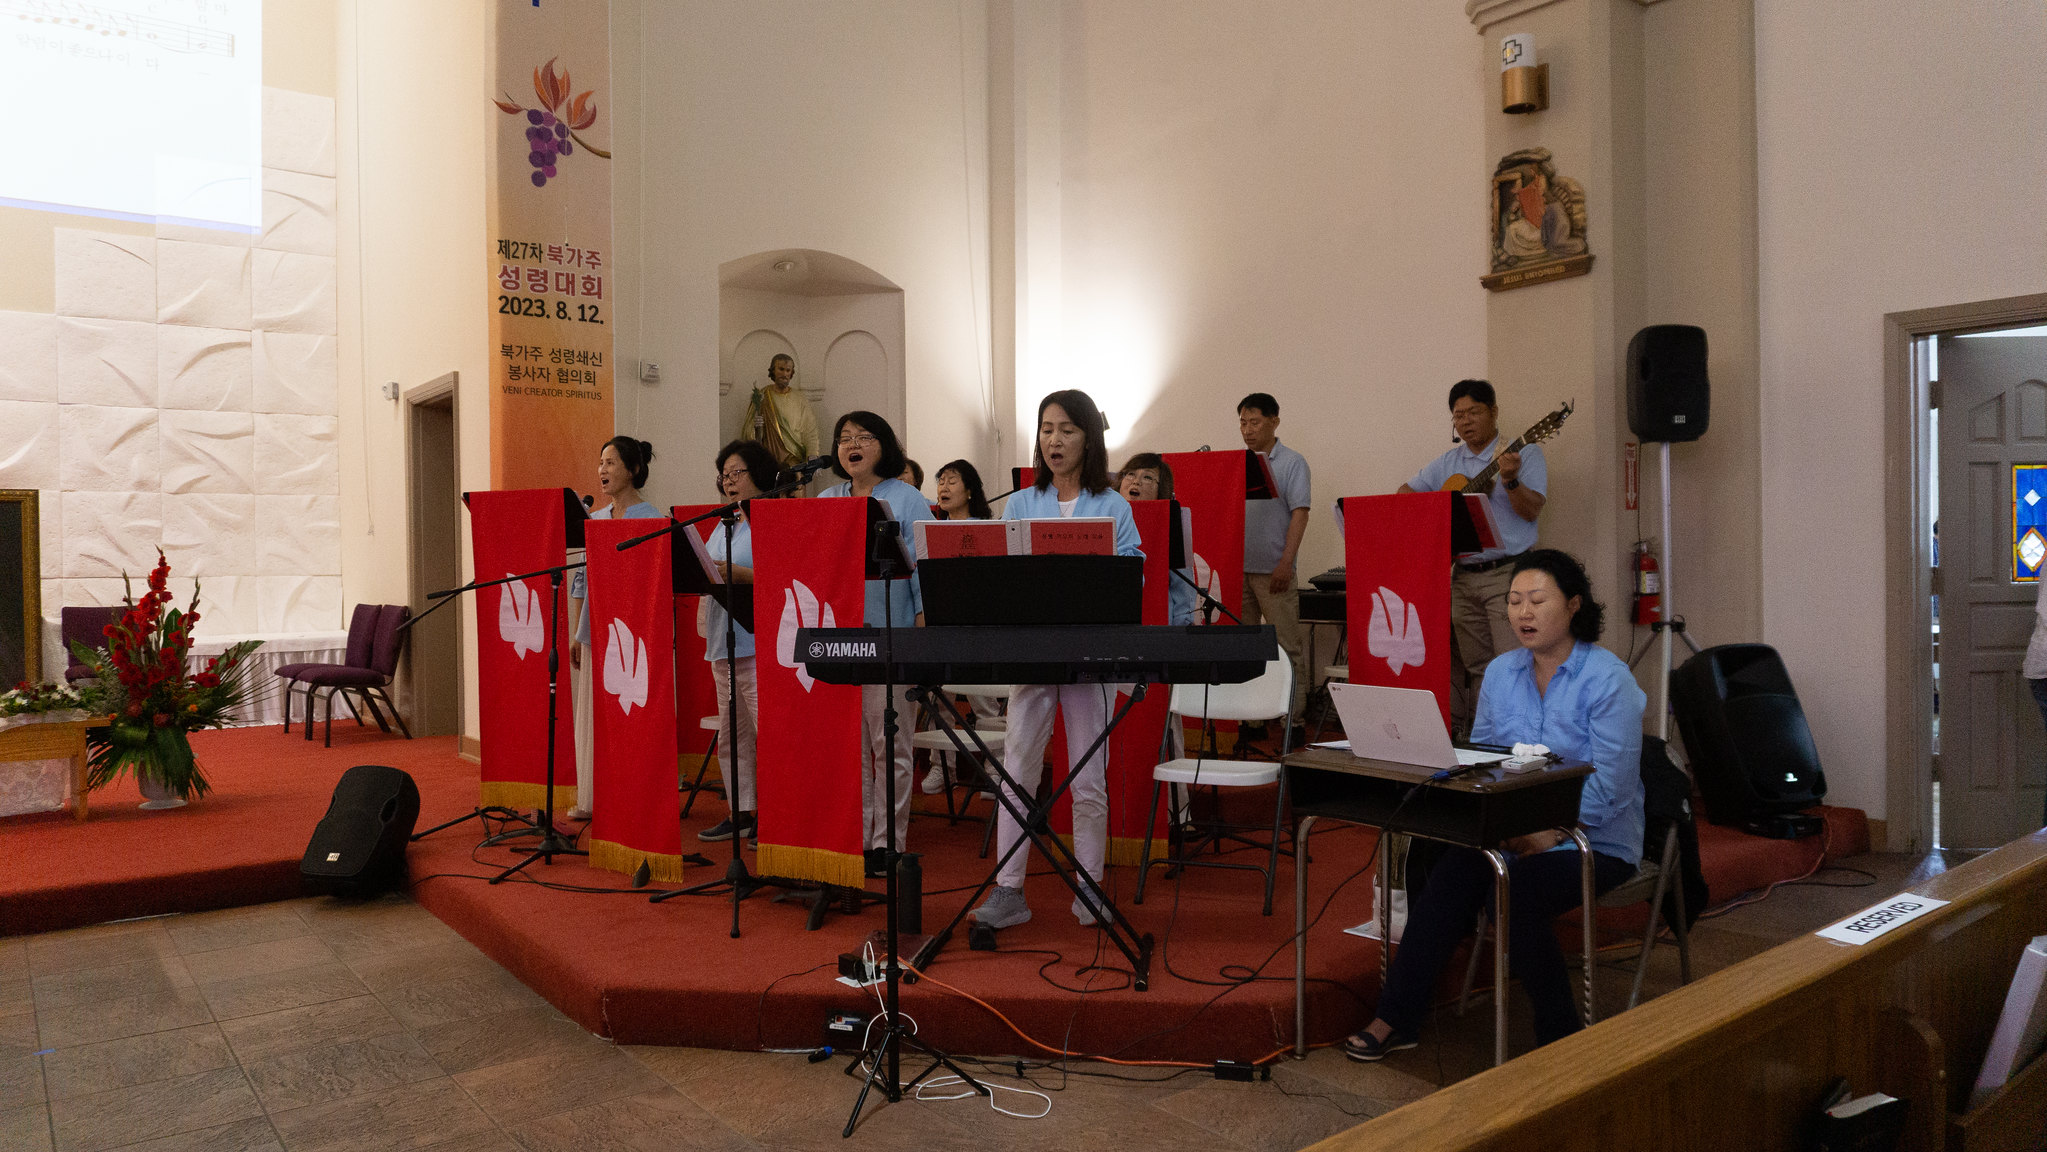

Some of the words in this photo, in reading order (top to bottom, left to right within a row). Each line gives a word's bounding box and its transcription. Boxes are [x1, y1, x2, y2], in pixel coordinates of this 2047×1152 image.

[497, 239, 543, 263] 제27차
[547, 244, 602, 270] 북가주
[498, 265, 603, 299] 성령대회
[498, 295, 550, 319] 2023.
[556, 301, 572, 321] 8.
[578, 304, 604, 324] 12.
[500, 344, 543, 362] 북가주
[549, 347, 602, 367] 성령쇄신
[508, 364, 550, 383] 봉사자
[556, 367, 596, 386] 협의회
[502, 385, 522, 395] VENI
[524, 386, 563, 398] CREATOR
[566, 390, 602, 400] SPIRITUS
[825, 642, 877, 657] YAMAHA
[1844, 901, 1924, 934] RESERVED
